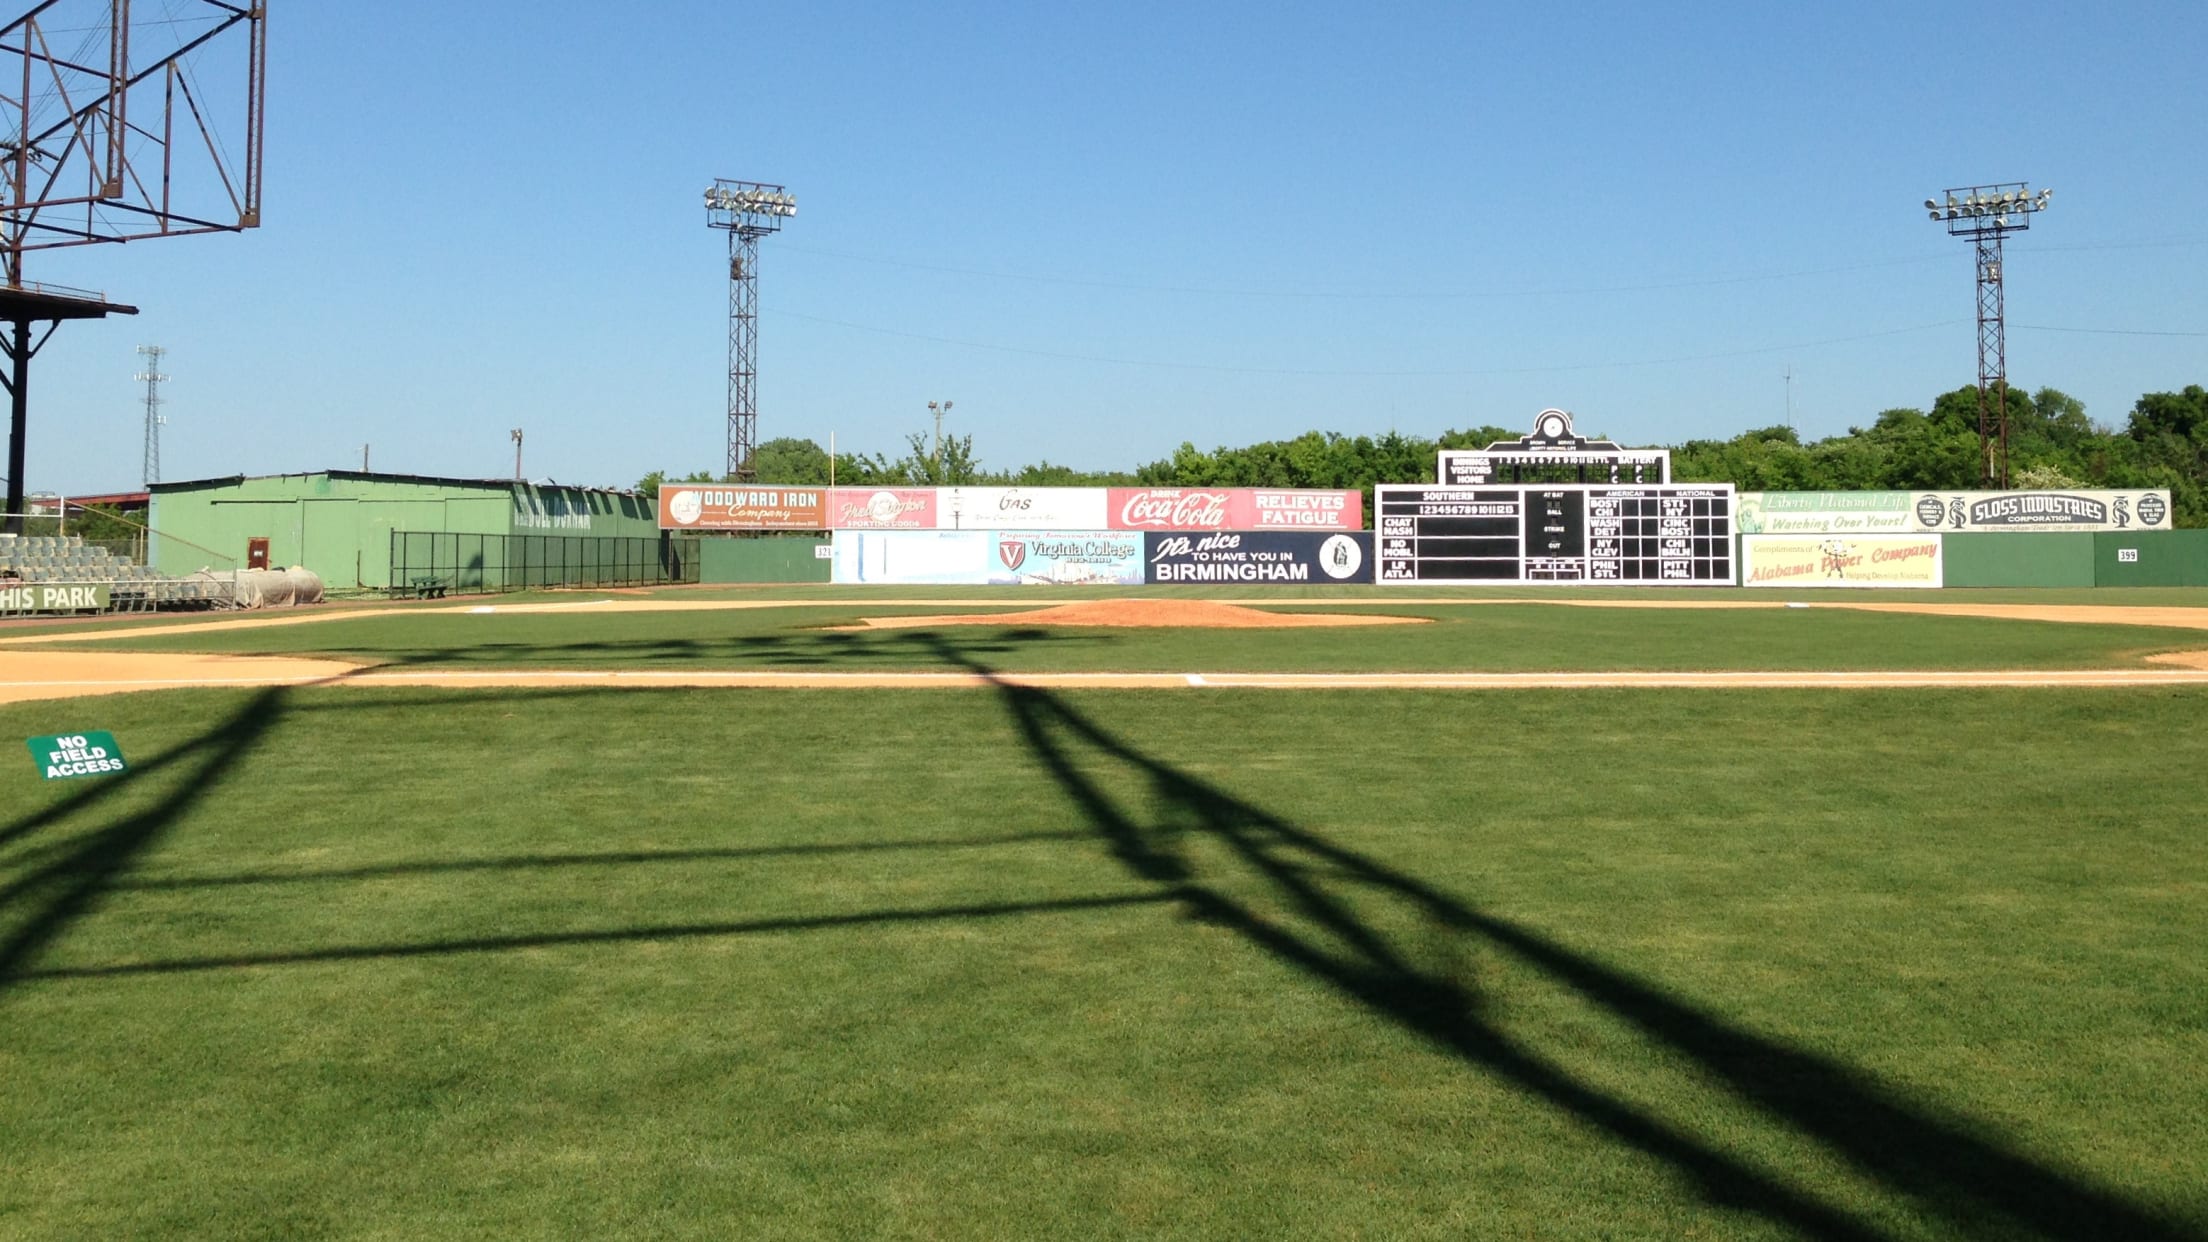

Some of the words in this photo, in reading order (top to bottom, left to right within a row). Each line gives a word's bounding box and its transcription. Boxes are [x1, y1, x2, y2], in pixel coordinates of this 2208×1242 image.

[1452, 458, 1490, 466] INNINGS
[1450, 466, 1492, 474] VISITORS
[1611, 465, 1618, 473] P
[1636, 465, 1642, 473] P
[1457, 476, 1484, 484] HOME
[1611, 476, 1618, 484] C
[1636, 476, 1643, 484] C
[1150, 490, 1182, 498] DRINK
[1423, 492, 1474, 500] SOUTHERN
[692, 490, 778, 507] WOODWARD
[784, 493, 817, 508] IRON
[1256, 496, 1345, 509] RELIEVES
[1590, 500, 1618, 508] BOST
[1663, 500, 1688, 508] STL
[728, 503, 791, 520] Company
[1595, 508, 1614, 516] CHI
[1975, 498, 2018, 522] SLOSS
[2019, 496, 2102, 520] INDUSTRIES
[1262, 511, 1339, 525] FATIGUE
[1384, 518, 1412, 527] CHAT
[1772, 518, 1830, 531] Watching
[1834, 516, 1862, 528] Over
[1866, 514, 1908, 528] Yours!
[1590, 520, 1620, 528] WASH
[1663, 520, 1688, 528] CINC
[1384, 527, 1413, 536] NASH
[1151, 536, 1193, 563] It's
[1196, 532, 1240, 551] nice
[1390, 540, 1406, 548] NO
[1596, 540, 1613, 548] NY
[1666, 540, 1686, 548] CHI
[1032, 541, 1084, 560] Virginia
[1085, 541, 1136, 560] College
[1592, 548, 1618, 556] CLEV
[1662, 548, 1690, 556] BKLN
[1753, 545, 1802, 554] Compliments
[1191, 552, 1210, 562] TO
[1212, 552, 1246, 562] HAVE
[1250, 552, 1278, 562] YOU
[1280, 552, 1293, 562] IN
[2120, 551, 2136, 560] 399
[1392, 561, 1406, 570] LR
[1592, 560, 1618, 569] PHIL
[1664, 560, 1690, 569] PITT
[1747, 562, 1814, 583] Alabama
[1821, 554, 1863, 573] Power
[1871, 543, 1938, 563] Company
[1156, 564, 1308, 580] BIRMINGHAM
[1384, 570, 1414, 578] ATLA
[1594, 570, 1616, 578] STL
[1664, 570, 1690, 578] PHIL
[44, 586, 98, 608] PARK
[56, 735, 88, 750] NO
[49, 746, 107, 764] FIELD
[47, 758, 124, 778] ACCESS
